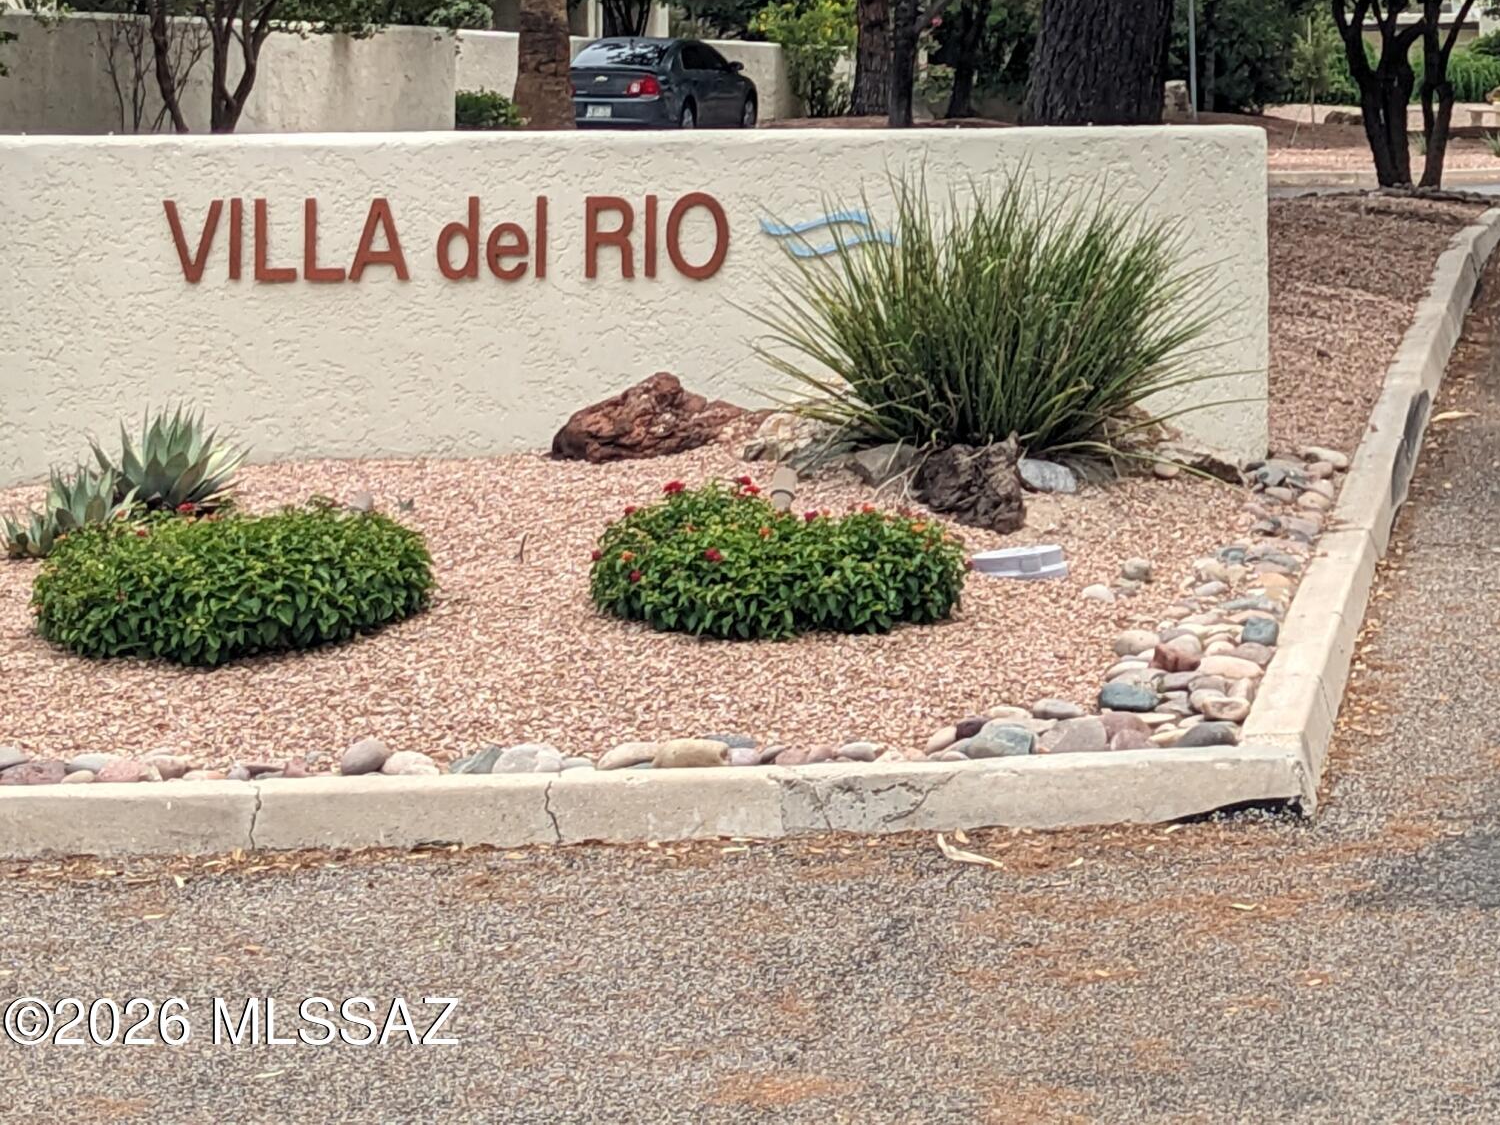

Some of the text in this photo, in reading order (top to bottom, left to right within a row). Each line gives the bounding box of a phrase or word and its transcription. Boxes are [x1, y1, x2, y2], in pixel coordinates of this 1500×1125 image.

[163, 191, 731, 284] VILLA del RIO
